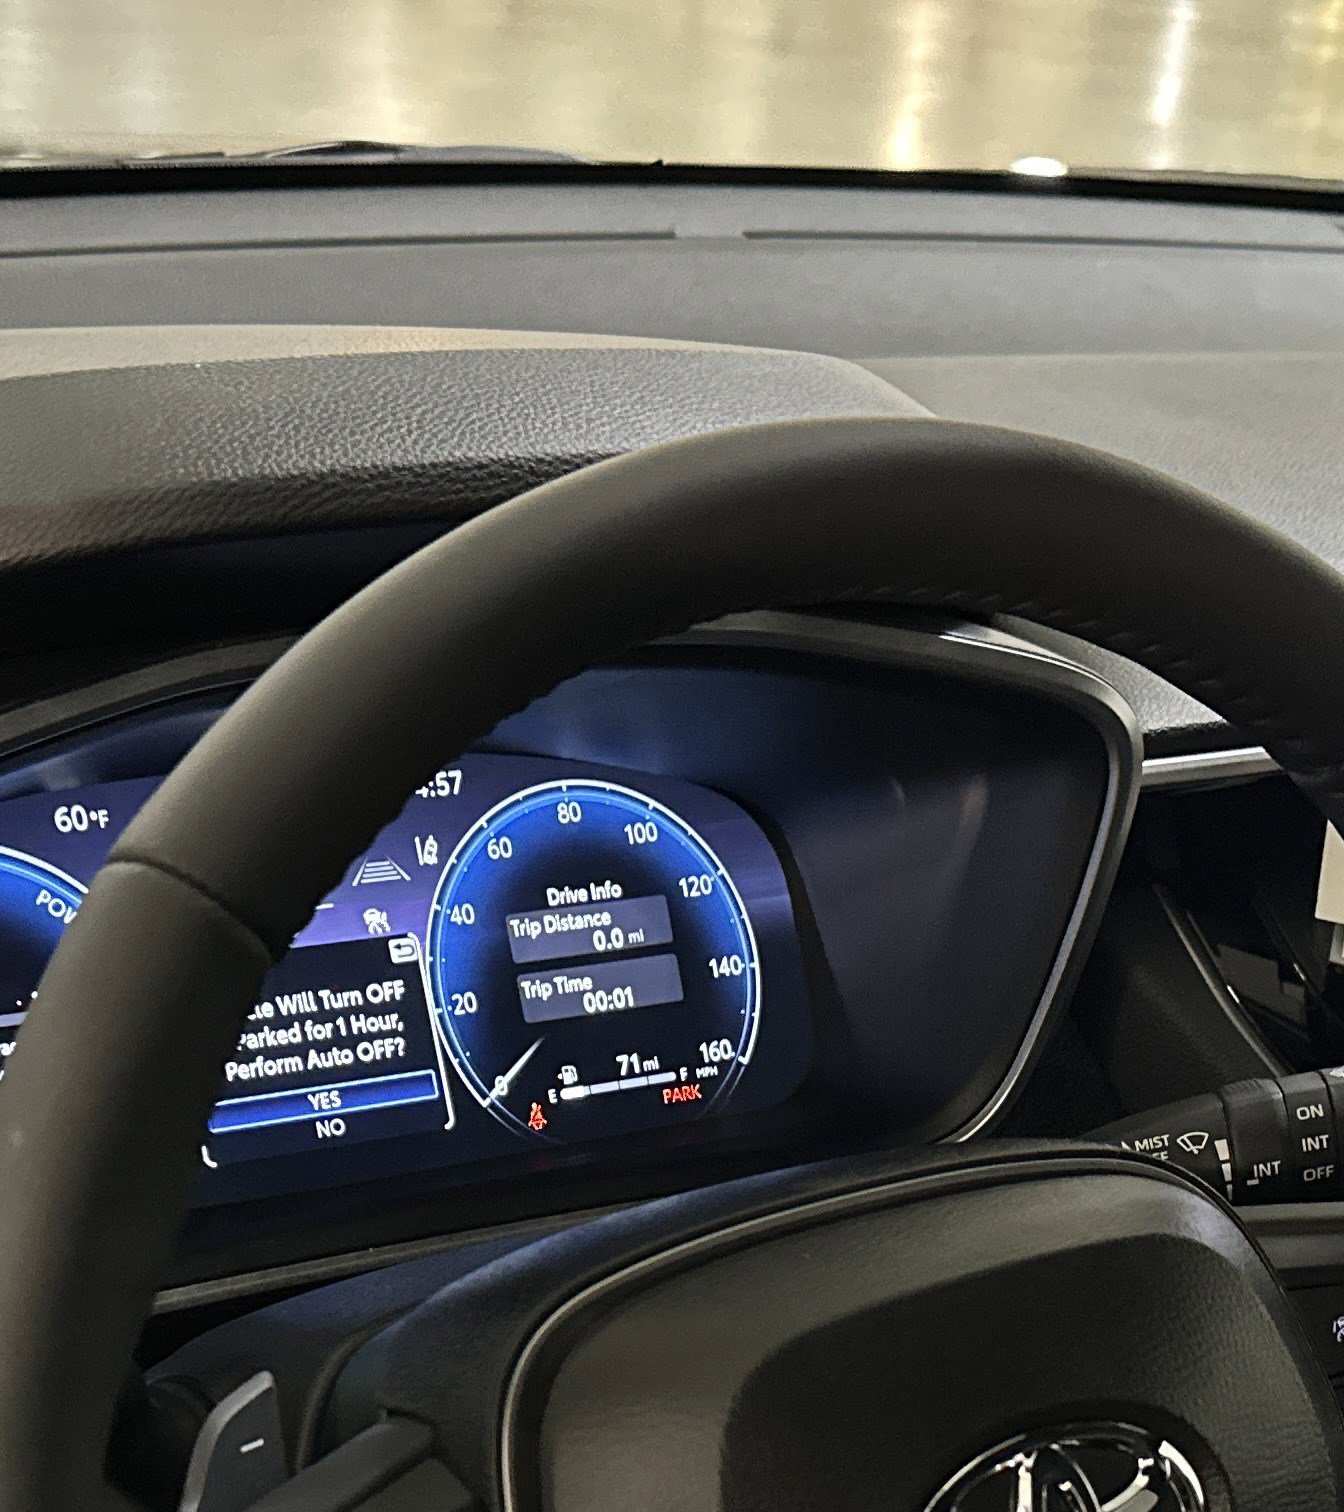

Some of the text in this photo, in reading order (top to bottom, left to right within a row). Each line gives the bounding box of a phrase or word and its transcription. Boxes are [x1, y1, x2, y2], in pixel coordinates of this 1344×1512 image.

[556, 801, 582, 825] 80
[623, 820, 659, 846] 100
[487, 836, 513, 860] 60
[545, 879, 623, 908] Drive Info
[678, 875, 712, 899] 120
[449, 902, 475, 926] 40
[509, 911, 613, 941] Trip Distance
[591, 927, 645, 952] 0.0 mi
[707, 954, 742, 979] 140
[273, 988, 318, 1018] Will
[317, 984, 363, 1012] Turn
[364, 978, 406, 1005] OFF
[520, 973, 594, 1002] Trip Time
[451, 990, 478, 1014] 20
[582, 985, 635, 1015] 00:01
[303, 1018, 334, 1041] for
[335, 1015, 348, 1038] 1
[350, 1011, 405, 1037] Hour,
[224, 1036, 406, 1083] Perform Auto OFF?
[698, 1039, 734, 1063] 160
[615, 1052, 660, 1076] 71 mi
[679, 1064, 719, 1083] F MPH
[306, 1089, 343, 1112] YES
[547, 1088, 558, 1105] E
[662, 1083, 704, 1106] PARK
[1295, 1103, 1324, 1122] ON
[315, 1117, 346, 1140] NO
[1134, 1133, 1170, 1152] MIST
[1301, 1134, 1330, 1153] INT
[1253, 1160, 1283, 1180] INT
[1302, 1164, 1335, 1183] OFF
